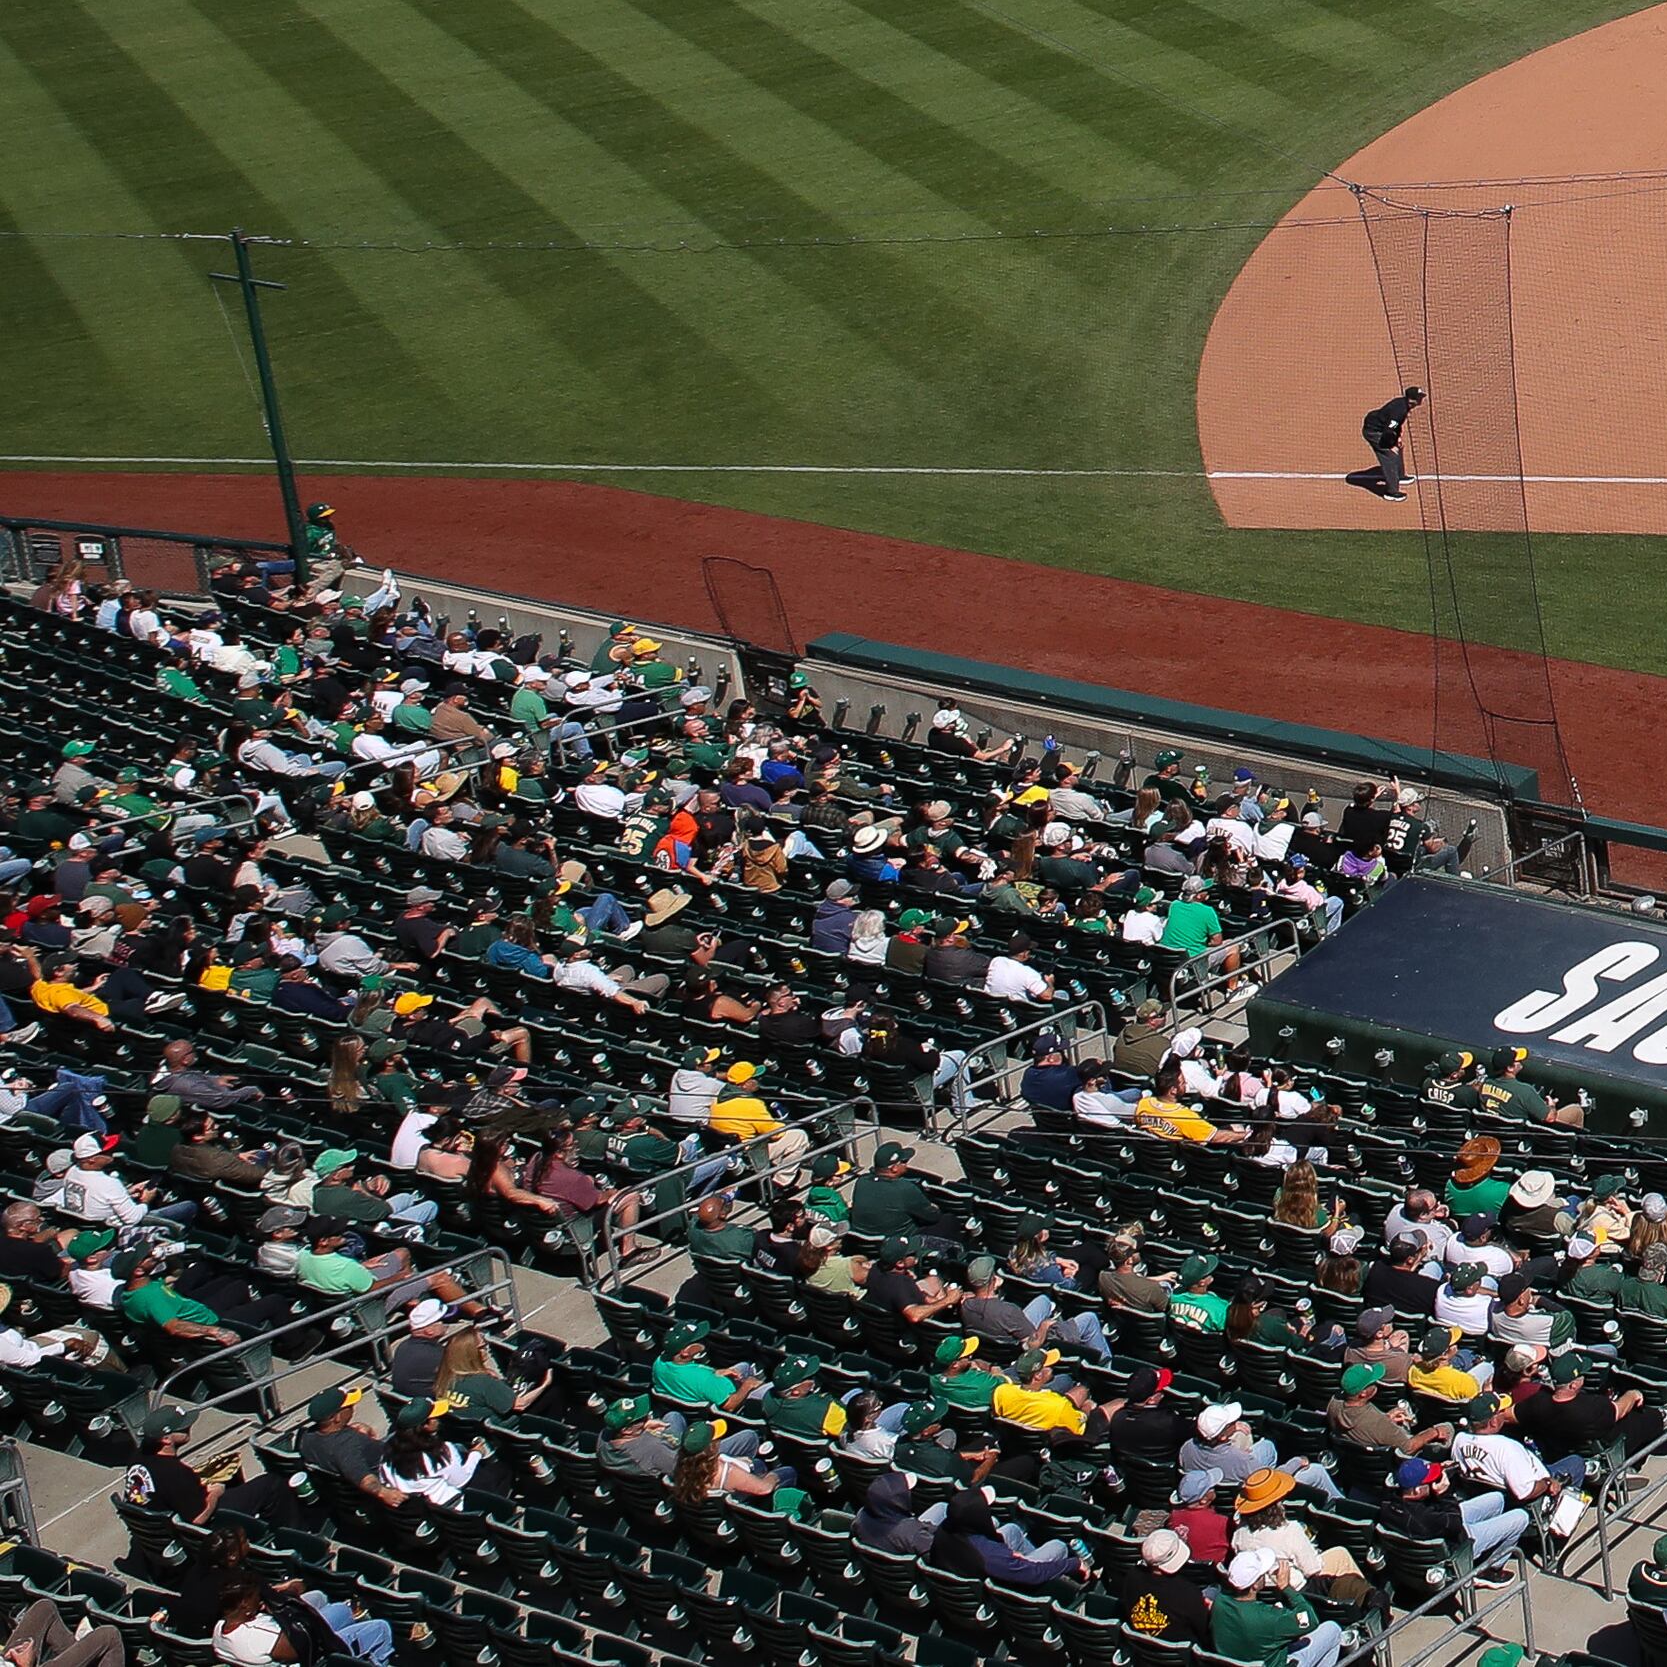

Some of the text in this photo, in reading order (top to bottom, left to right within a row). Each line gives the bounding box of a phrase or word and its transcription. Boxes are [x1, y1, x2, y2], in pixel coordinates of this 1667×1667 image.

[621, 828, 648, 855] 25
[1387, 829, 1408, 849] 25
[1427, 1087, 1455, 1104] CRISP
[1461, 1445, 1488, 1462] KURTZ
